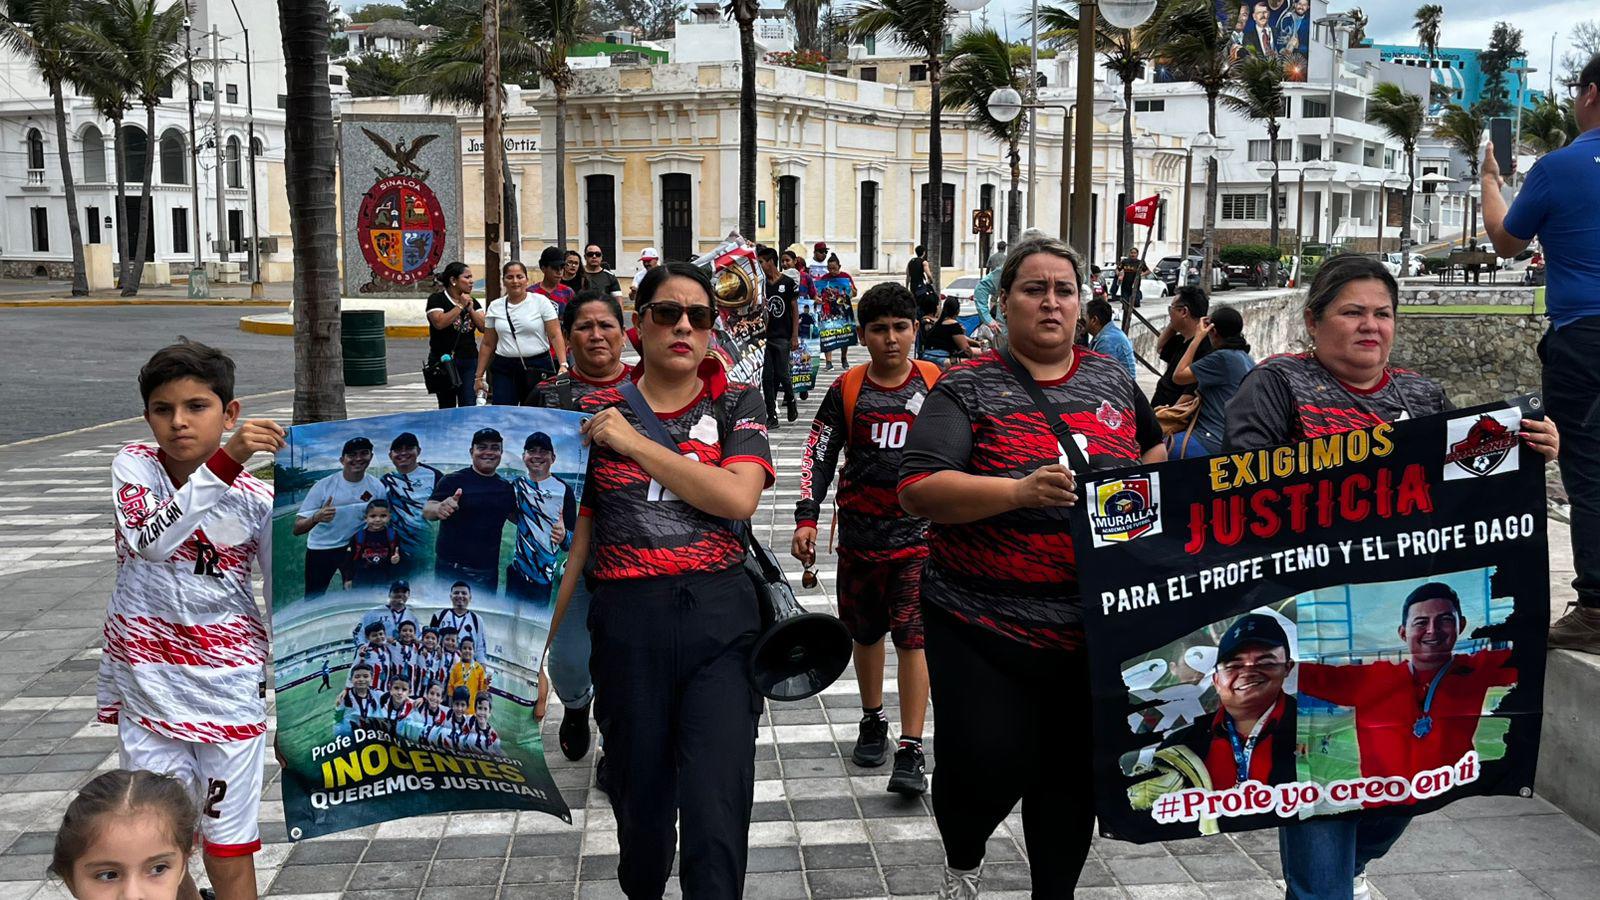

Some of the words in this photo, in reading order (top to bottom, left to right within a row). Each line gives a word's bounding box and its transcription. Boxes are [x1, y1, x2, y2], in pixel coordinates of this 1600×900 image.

[468, 139, 485, 152] Jos
[505, 138, 537, 151] Ortiz
[380, 181, 421, 191] SINALOA
[871, 421, 908, 449] 40
[800, 418, 825, 501] DRAGONE
[1209, 423, 1395, 492] EXIGIMOS
[1096, 508, 1154, 528] MURALLA
[1184, 463, 1434, 556] JUSTICIA
[1101, 581, 1160, 616] PARA
[1167, 574, 1193, 602] EL
[1200, 557, 1263, 594] PROFE
[1271, 543, 1330, 575] TEMO
[1338, 540, 1352, 565] Y
[1362, 536, 1390, 562] EL
[1397, 524, 1466, 558] PROFE
[1474, 513, 1534, 546] DAGO
[312, 735, 352, 761] Profe
[494, 757, 524, 767] son
[322, 743, 527, 789] INOCENTES
[311, 774, 435, 810] QUEREMOS
[441, 776, 547, 800] JUSTICIA!!
[1157, 784, 1271, 820] #Profe
[1281, 785, 1320, 813] yo
[1330, 778, 1405, 800] creo
[1415, 769, 1450, 794] en
[1460, 755, 1476, 781] ti
